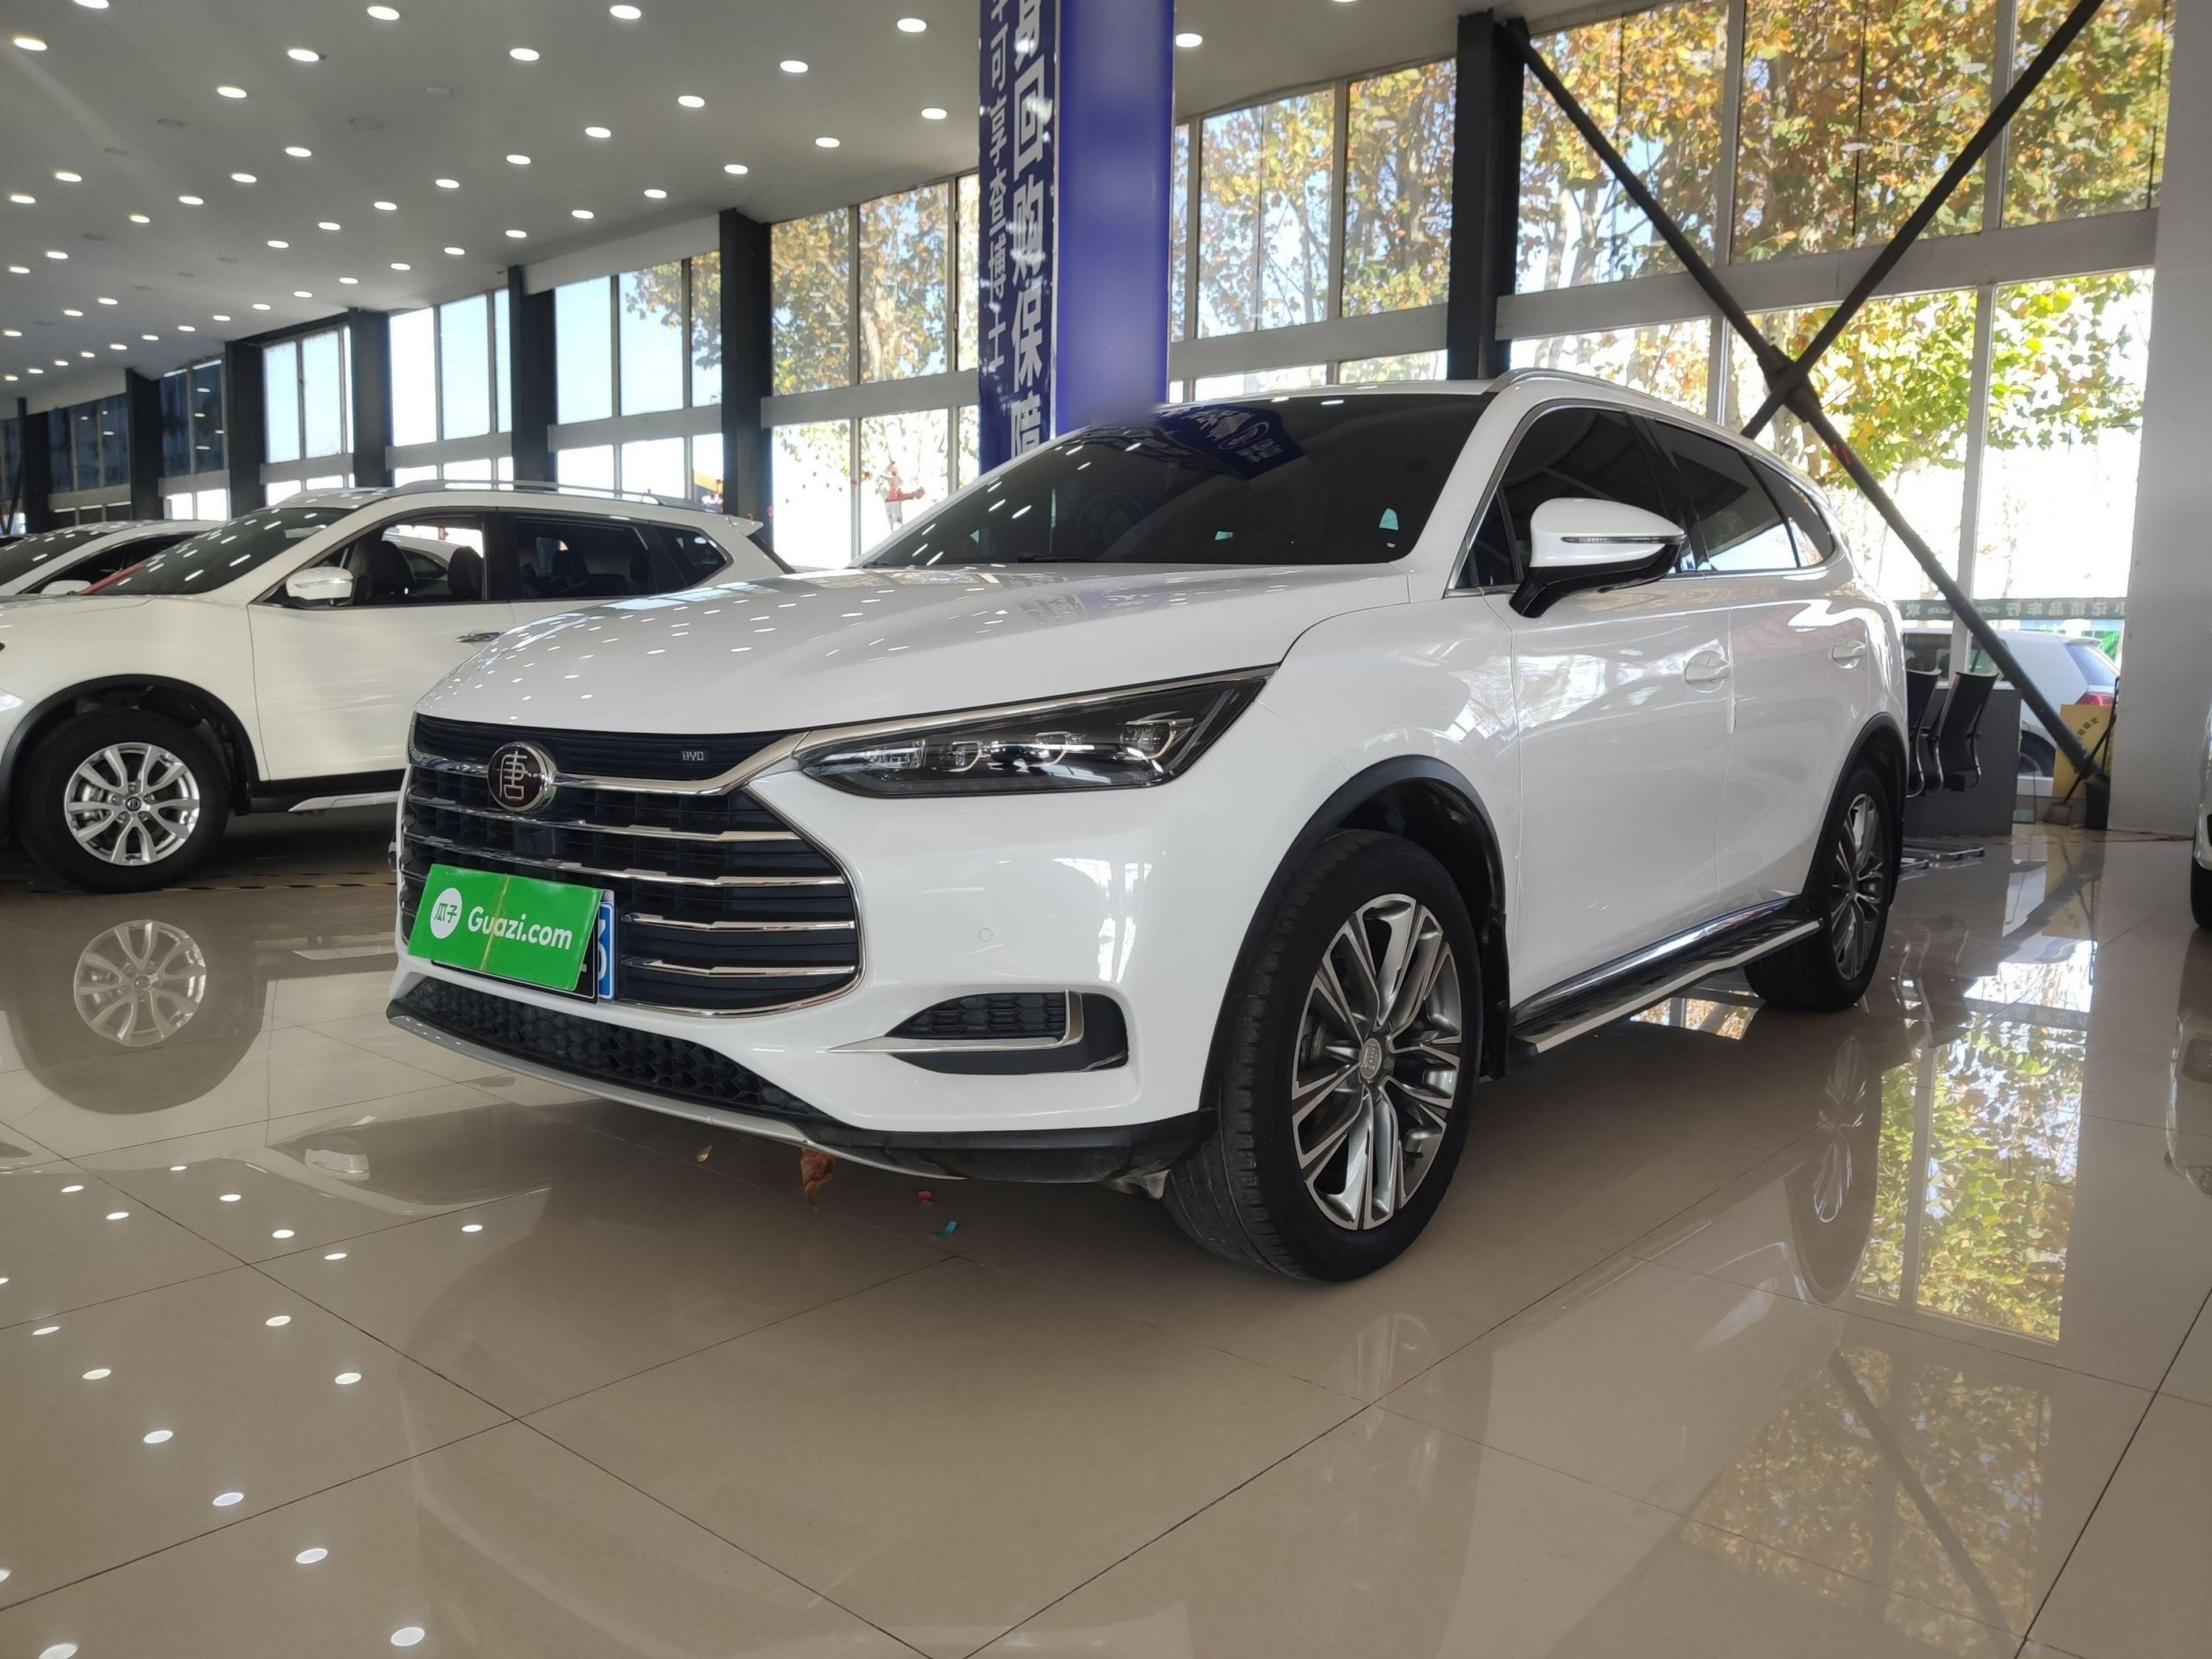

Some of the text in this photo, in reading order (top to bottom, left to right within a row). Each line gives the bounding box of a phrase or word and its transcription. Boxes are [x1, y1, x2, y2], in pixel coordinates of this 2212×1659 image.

[681, 751, 704, 761] BYD
[497, 750, 528, 801] 唐
[433, 902, 458, 923] 瓜子
[468, 906, 573, 950] Guazi.com
